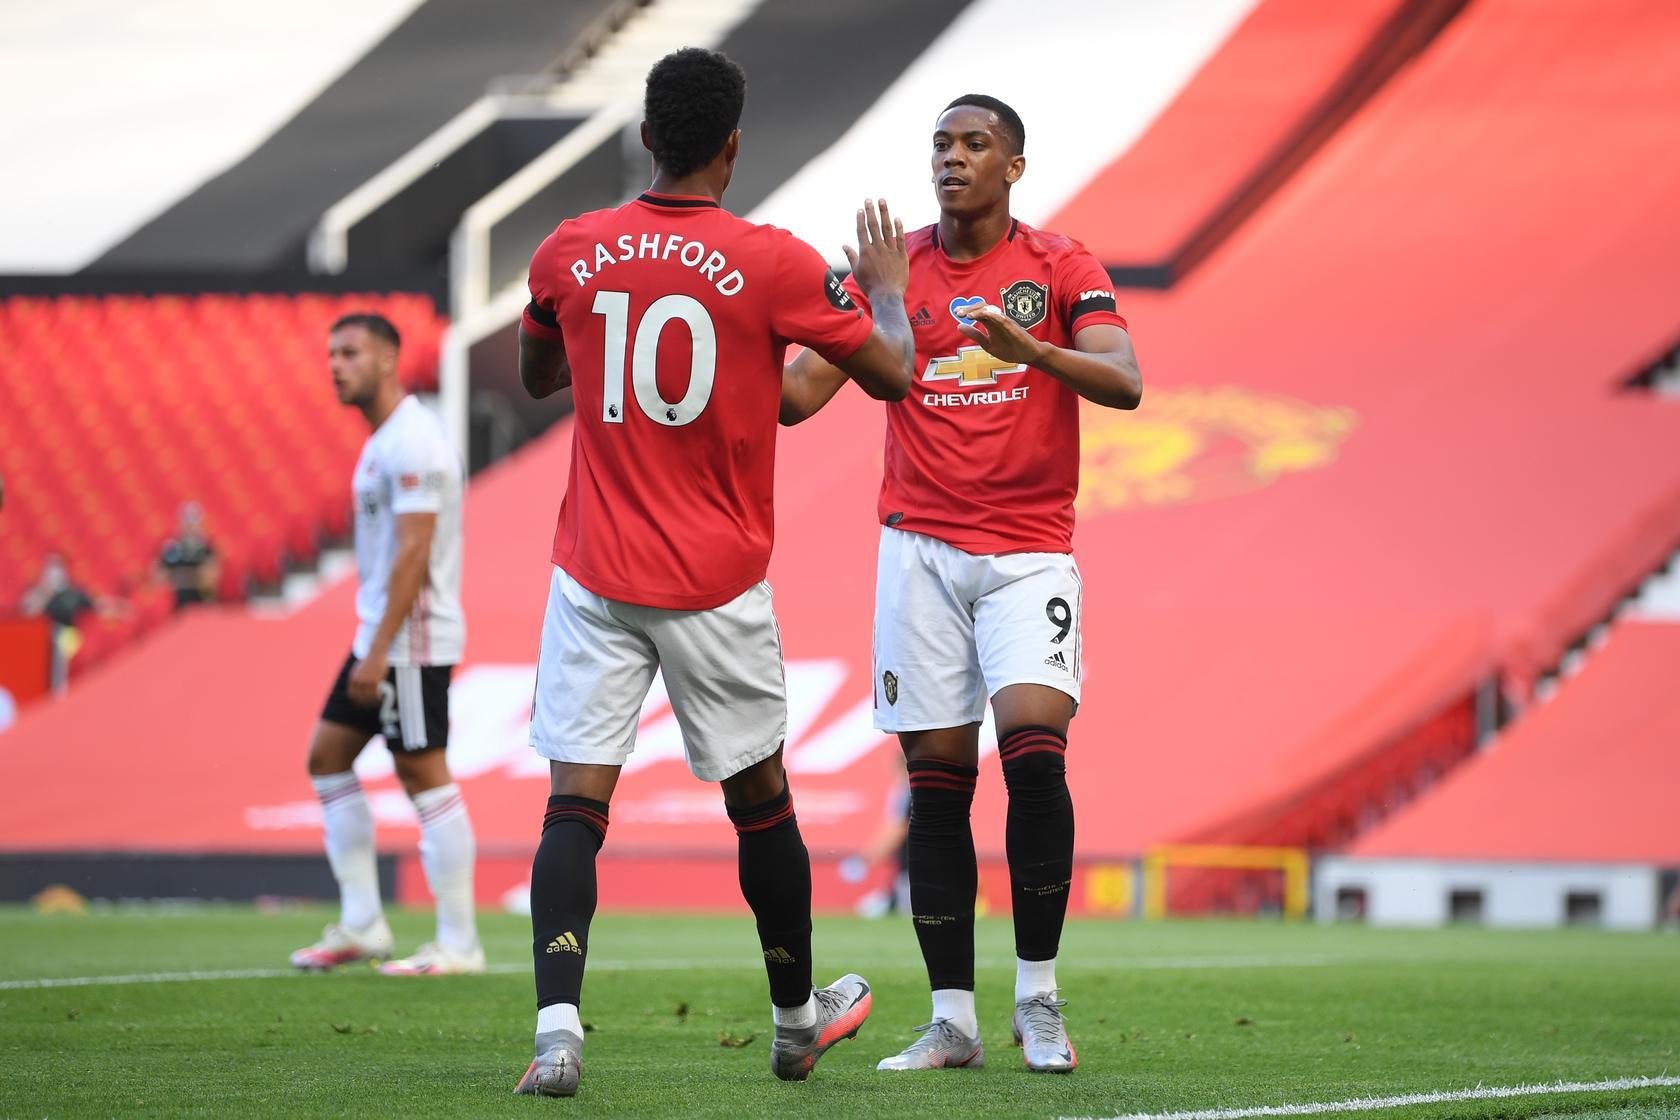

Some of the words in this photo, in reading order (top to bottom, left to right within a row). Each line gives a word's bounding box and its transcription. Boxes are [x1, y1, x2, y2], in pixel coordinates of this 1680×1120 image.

[570, 233, 744, 296] RASHFORD
[591, 290, 717, 427] 10
[922, 386, 1030, 407] CHEVROLET
[1046, 597, 1072, 645] 9
[1044, 658, 1069, 673] adidas
[546, 943, 582, 956] adidas
